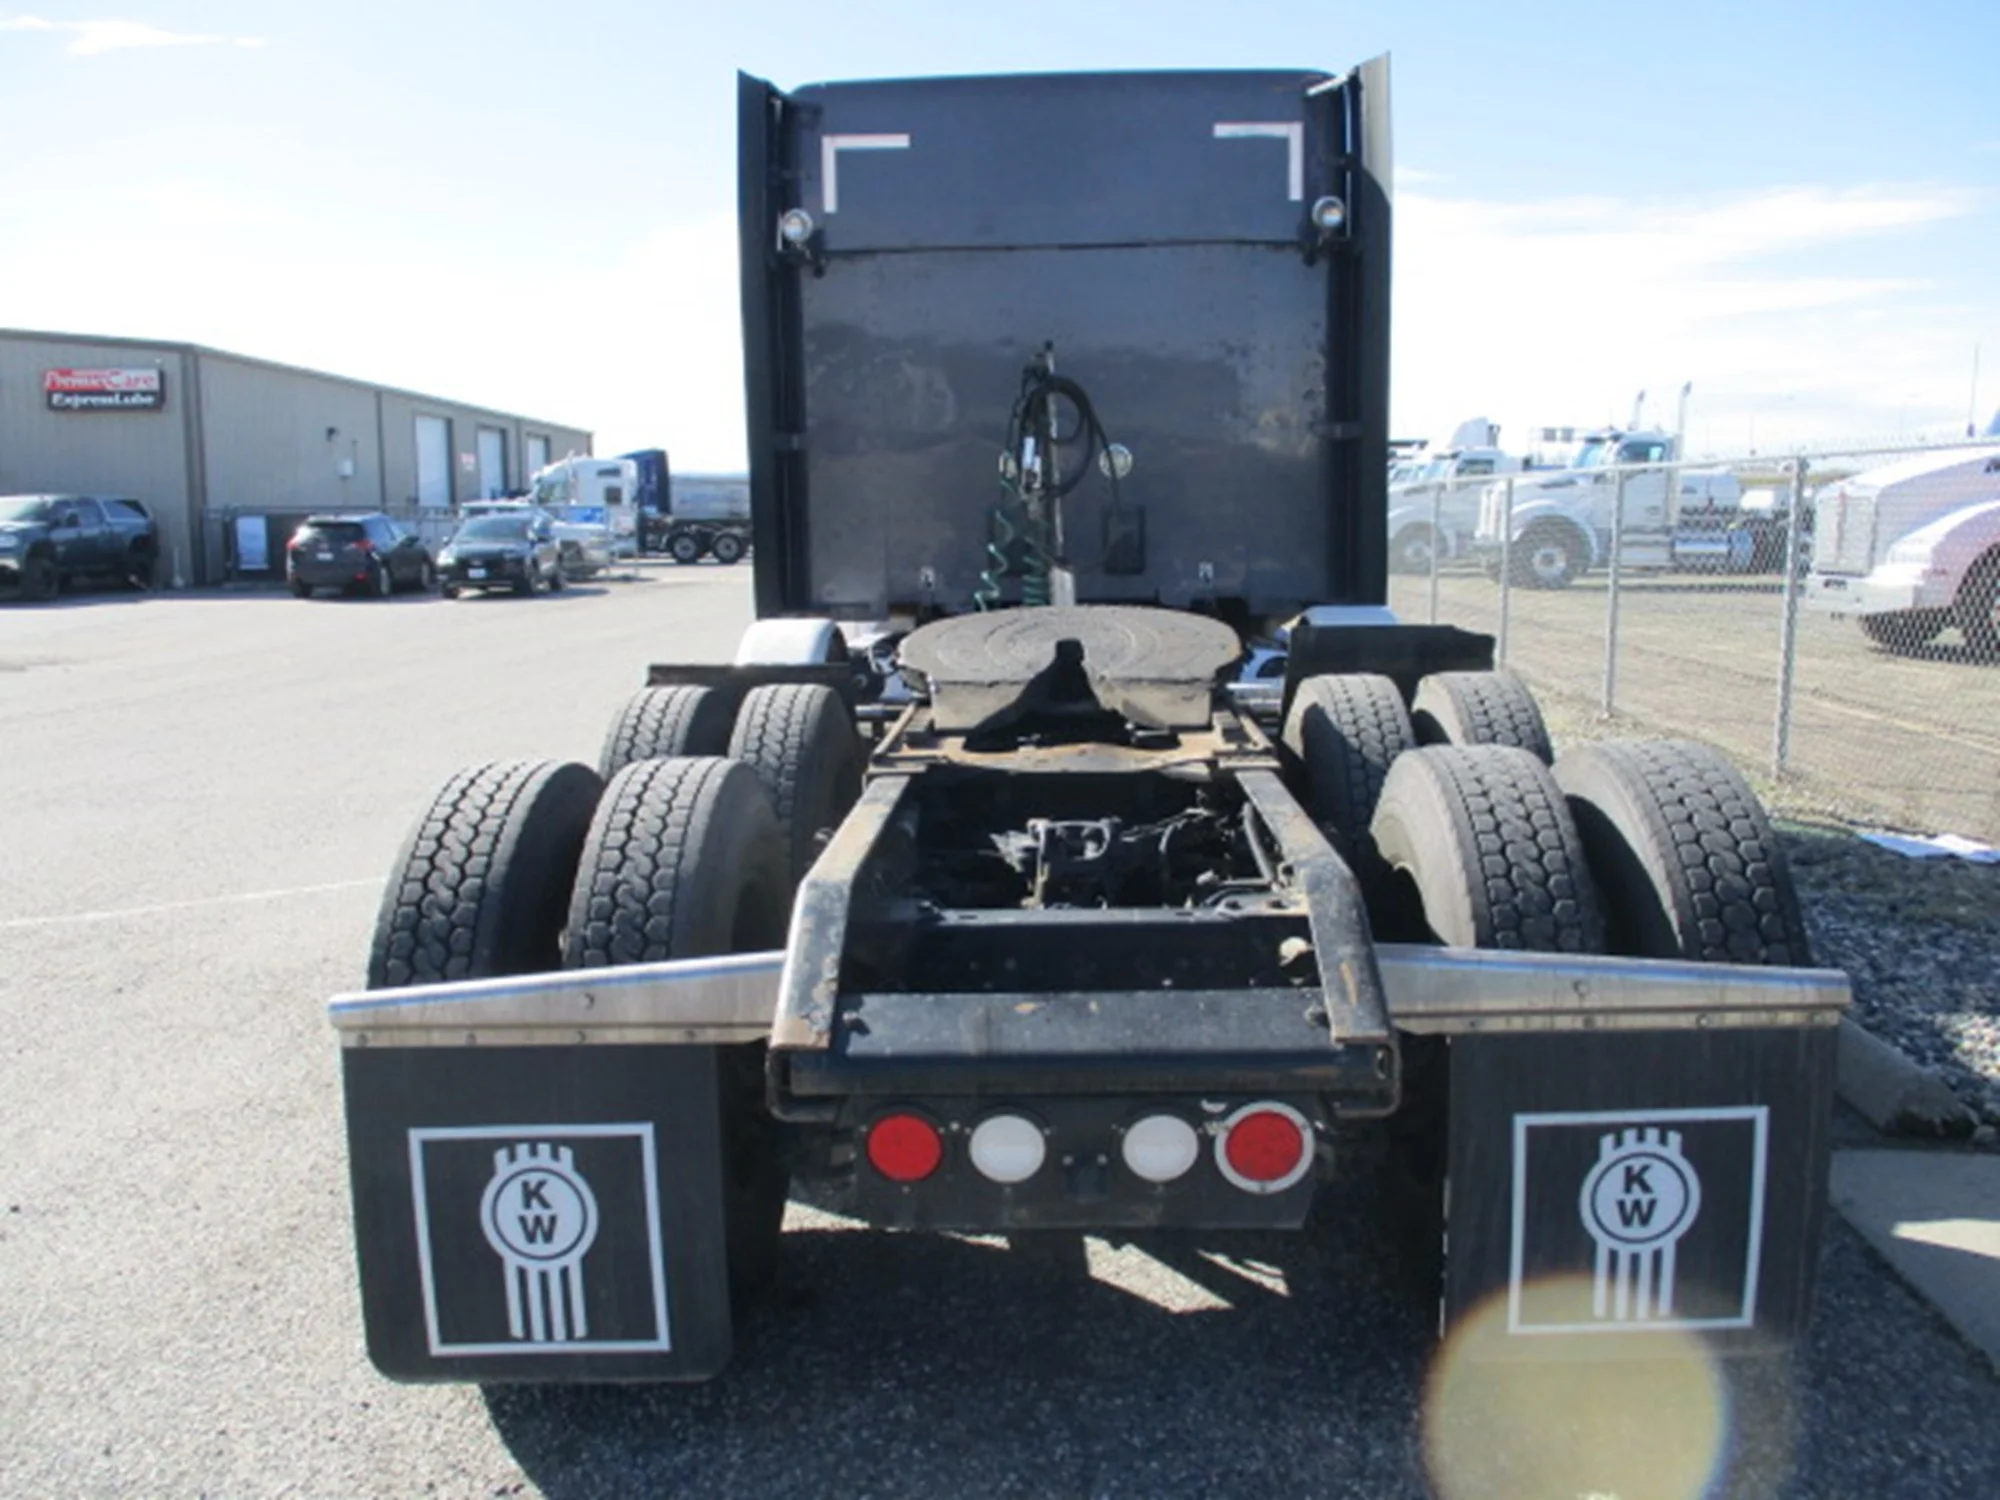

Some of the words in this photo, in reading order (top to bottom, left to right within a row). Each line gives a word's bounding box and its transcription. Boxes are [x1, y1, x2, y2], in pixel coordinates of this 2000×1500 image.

[1624, 1164, 1654, 1194] K
[521, 1180, 552, 1210] K
[1616, 1198, 1658, 1228] W
[518, 1214, 558, 1244] W
